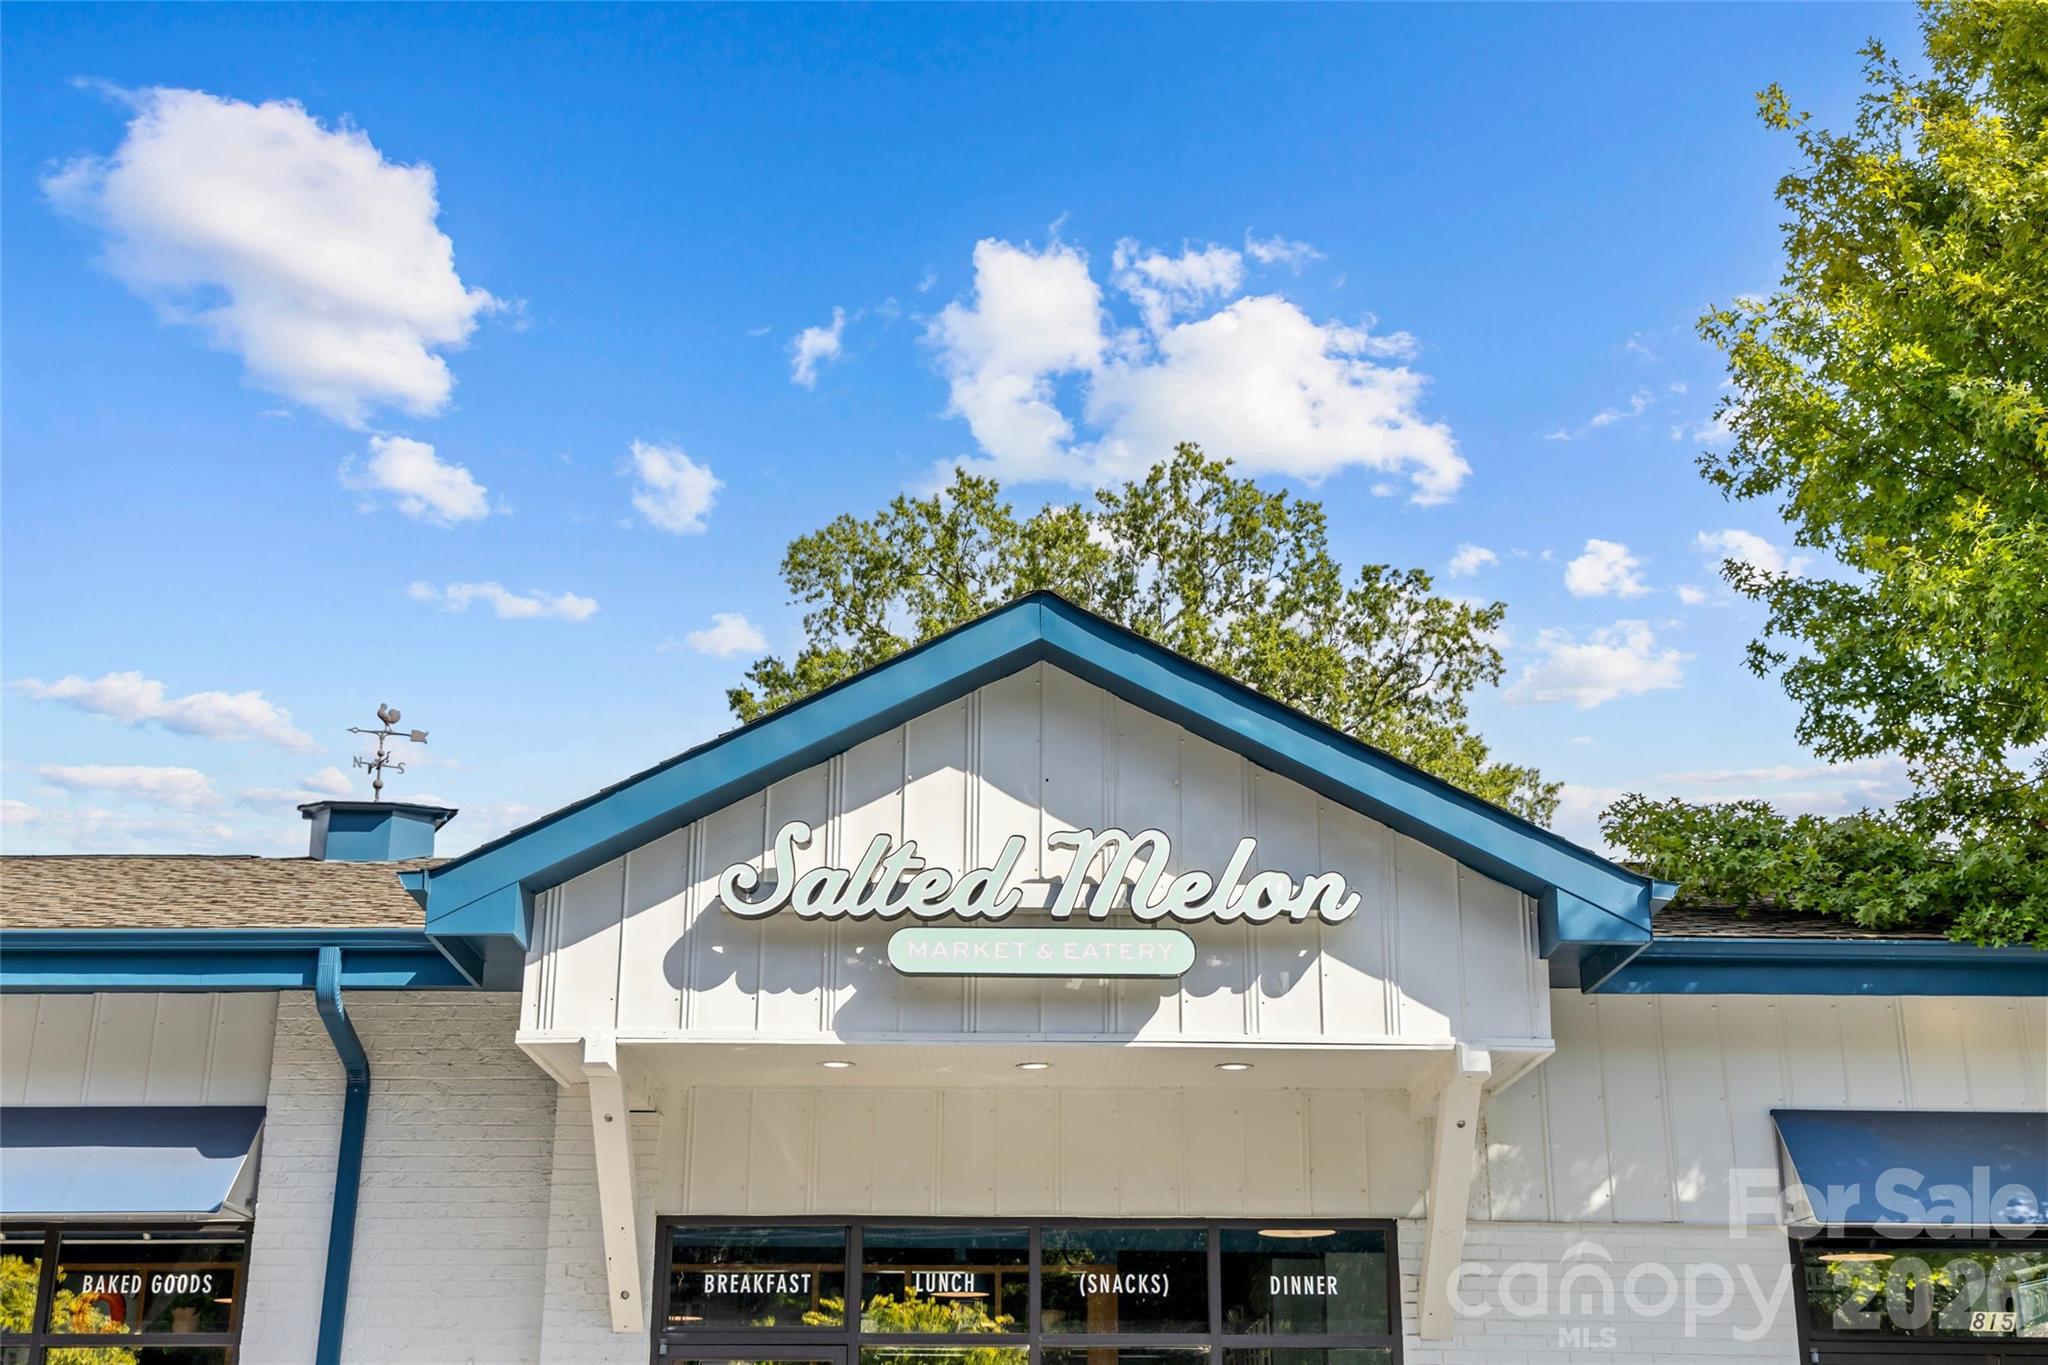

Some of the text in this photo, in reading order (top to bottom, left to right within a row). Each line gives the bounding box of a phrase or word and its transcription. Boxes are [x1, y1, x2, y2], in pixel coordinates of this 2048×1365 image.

[719, 820, 1362, 923] Salted Melon
[907, 941, 1174, 960] MARKET & EATERY
[82, 1274, 213, 1294] BAKED GOODS
[704, 1273, 812, 1294] BREAKFAST
[915, 1273, 976, 1293] LUNCH
[1079, 1273, 1170, 1297] (SNACKS)
[1269, 1275, 1339, 1295] DINNER
[1973, 1313, 2014, 1331] 815
